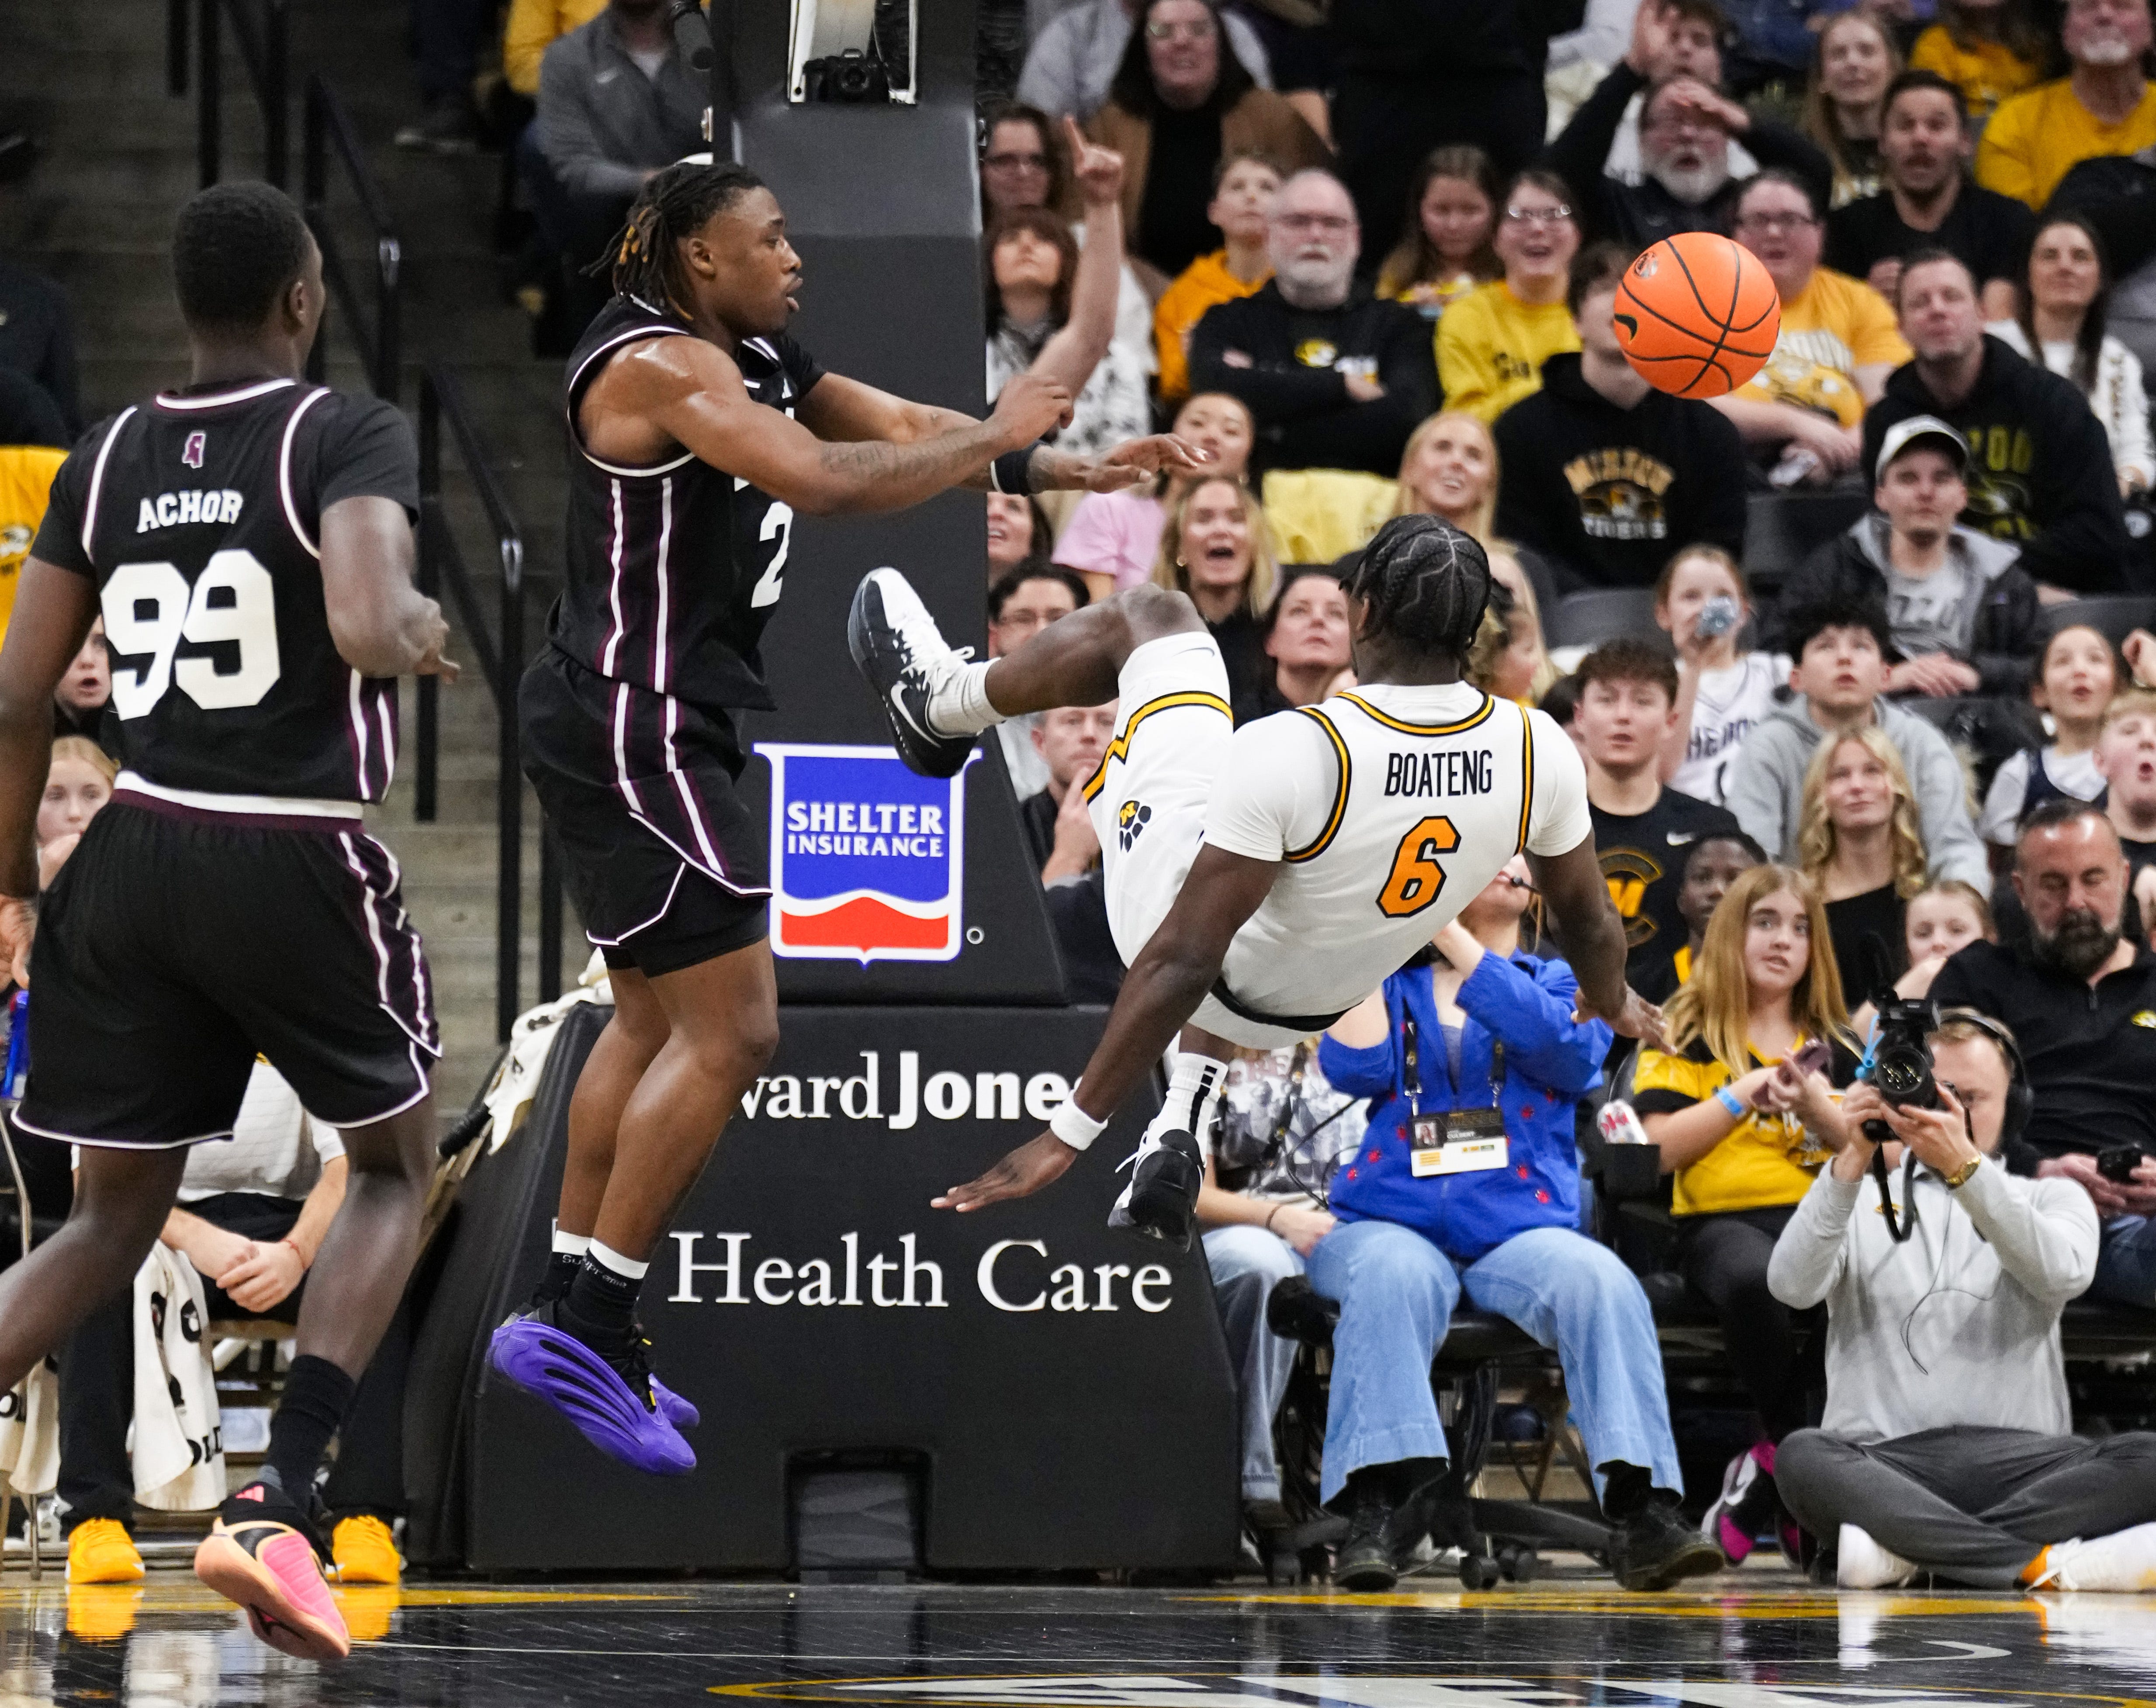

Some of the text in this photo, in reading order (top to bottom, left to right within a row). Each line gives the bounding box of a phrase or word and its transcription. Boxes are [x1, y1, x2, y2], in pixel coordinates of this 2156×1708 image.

[136, 489, 244, 534] ACHOR
[751, 501, 794, 609] 2
[100, 549, 280, 721] 99
[1384, 750, 1492, 797] BOATENG
[787, 801, 945, 835] SHELTER
[787, 833, 944, 857] INSURANCE
[1376, 816, 1461, 918] 6
[888, 1051, 1083, 1130] Jone
[667, 1231, 1172, 1312] Health Care
